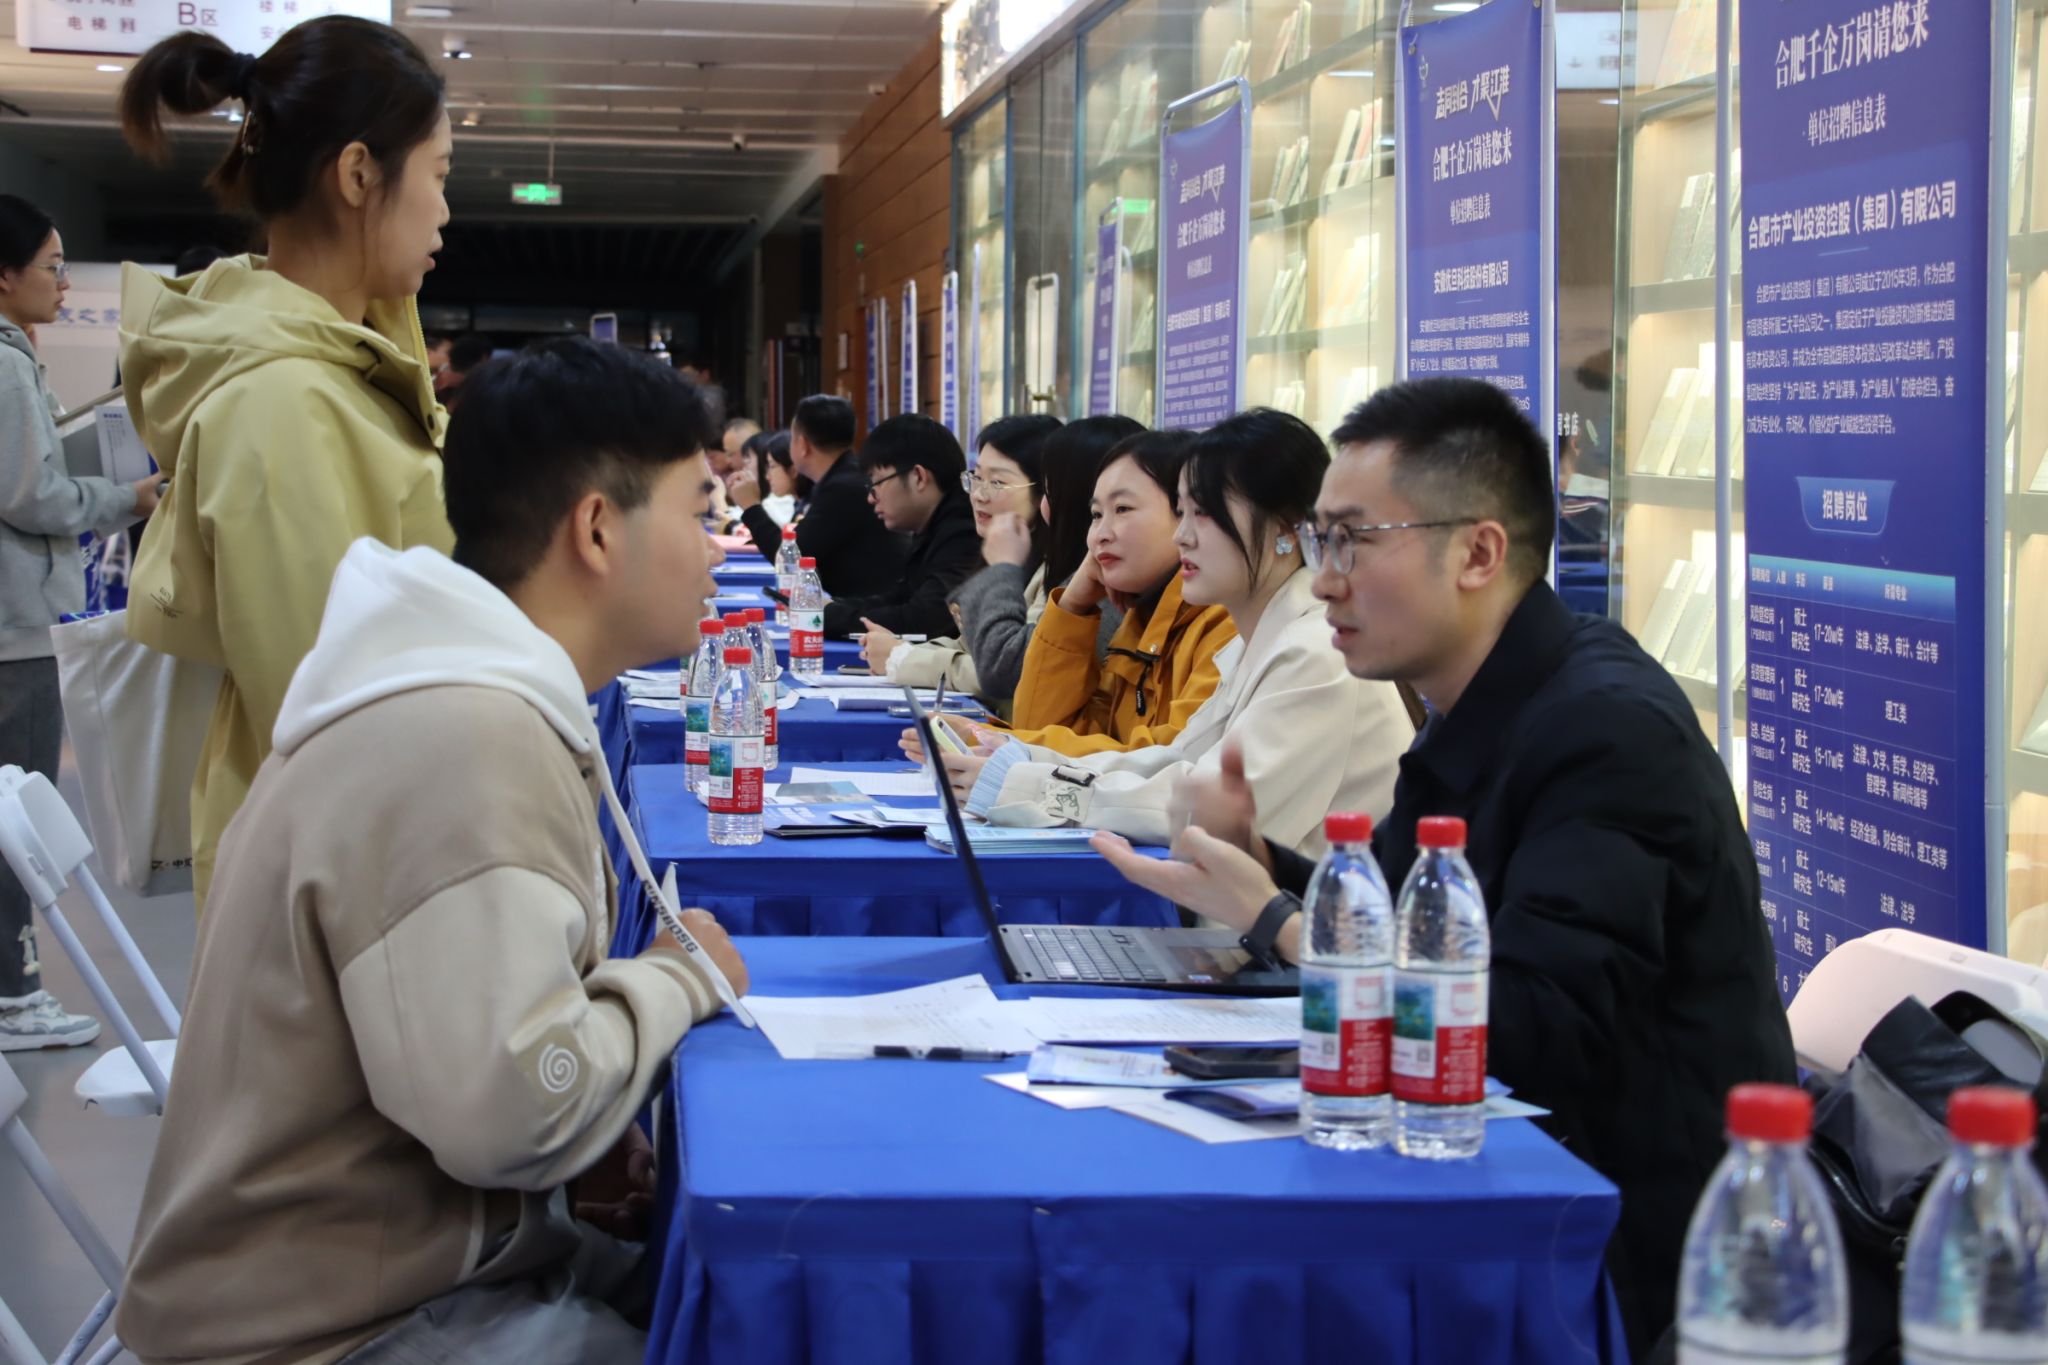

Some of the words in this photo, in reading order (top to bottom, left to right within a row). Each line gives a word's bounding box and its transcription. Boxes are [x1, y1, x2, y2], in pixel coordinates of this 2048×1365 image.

[1775, 0, 1930, 89] 合肥千企万岗请您来
[1807, 93, 1886, 147] 单位招聘信息表
[1433, 127, 1512, 182] 合肥千企万岗请您来
[1450, 192, 1491, 225] 单位招聘信息表
[1748, 180, 1957, 250] 合肥市产业投资控股（集团）有限公司
[1822, 489, 1868, 522] 招聘岗位
[1794, 607, 1807, 627] 硕士
[1791, 632, 1810, 652] 研究生
[1855, 629, 1939, 664] 法律、法学、审计、会计等
[1794, 668, 1808, 688] 硕士
[1792, 692, 1811, 713] 研究生
[1780, 737, 1785, 754] 2
[1795, 728, 1808, 749] 硕士
[1792, 752, 1811, 775] 研究生
[1853, 743, 1939, 786] 法律、文学、哲学、经济学、
[1795, 789, 1808, 810] 硕士
[1866, 773, 1928, 810] 管理学、新闻传播等
[1781, 797, 1786, 815] 5
[1792, 812, 1812, 836] 研究生
[1795, 849, 1809, 871] 硕士
[1793, 872, 1812, 896] 研究生
[1797, 909, 1810, 931] 硕士
[1880, 893, 1916, 925] 法律、法学
[1793, 932, 1813, 957] 研究生
[1783, 975, 1788, 993] 6
